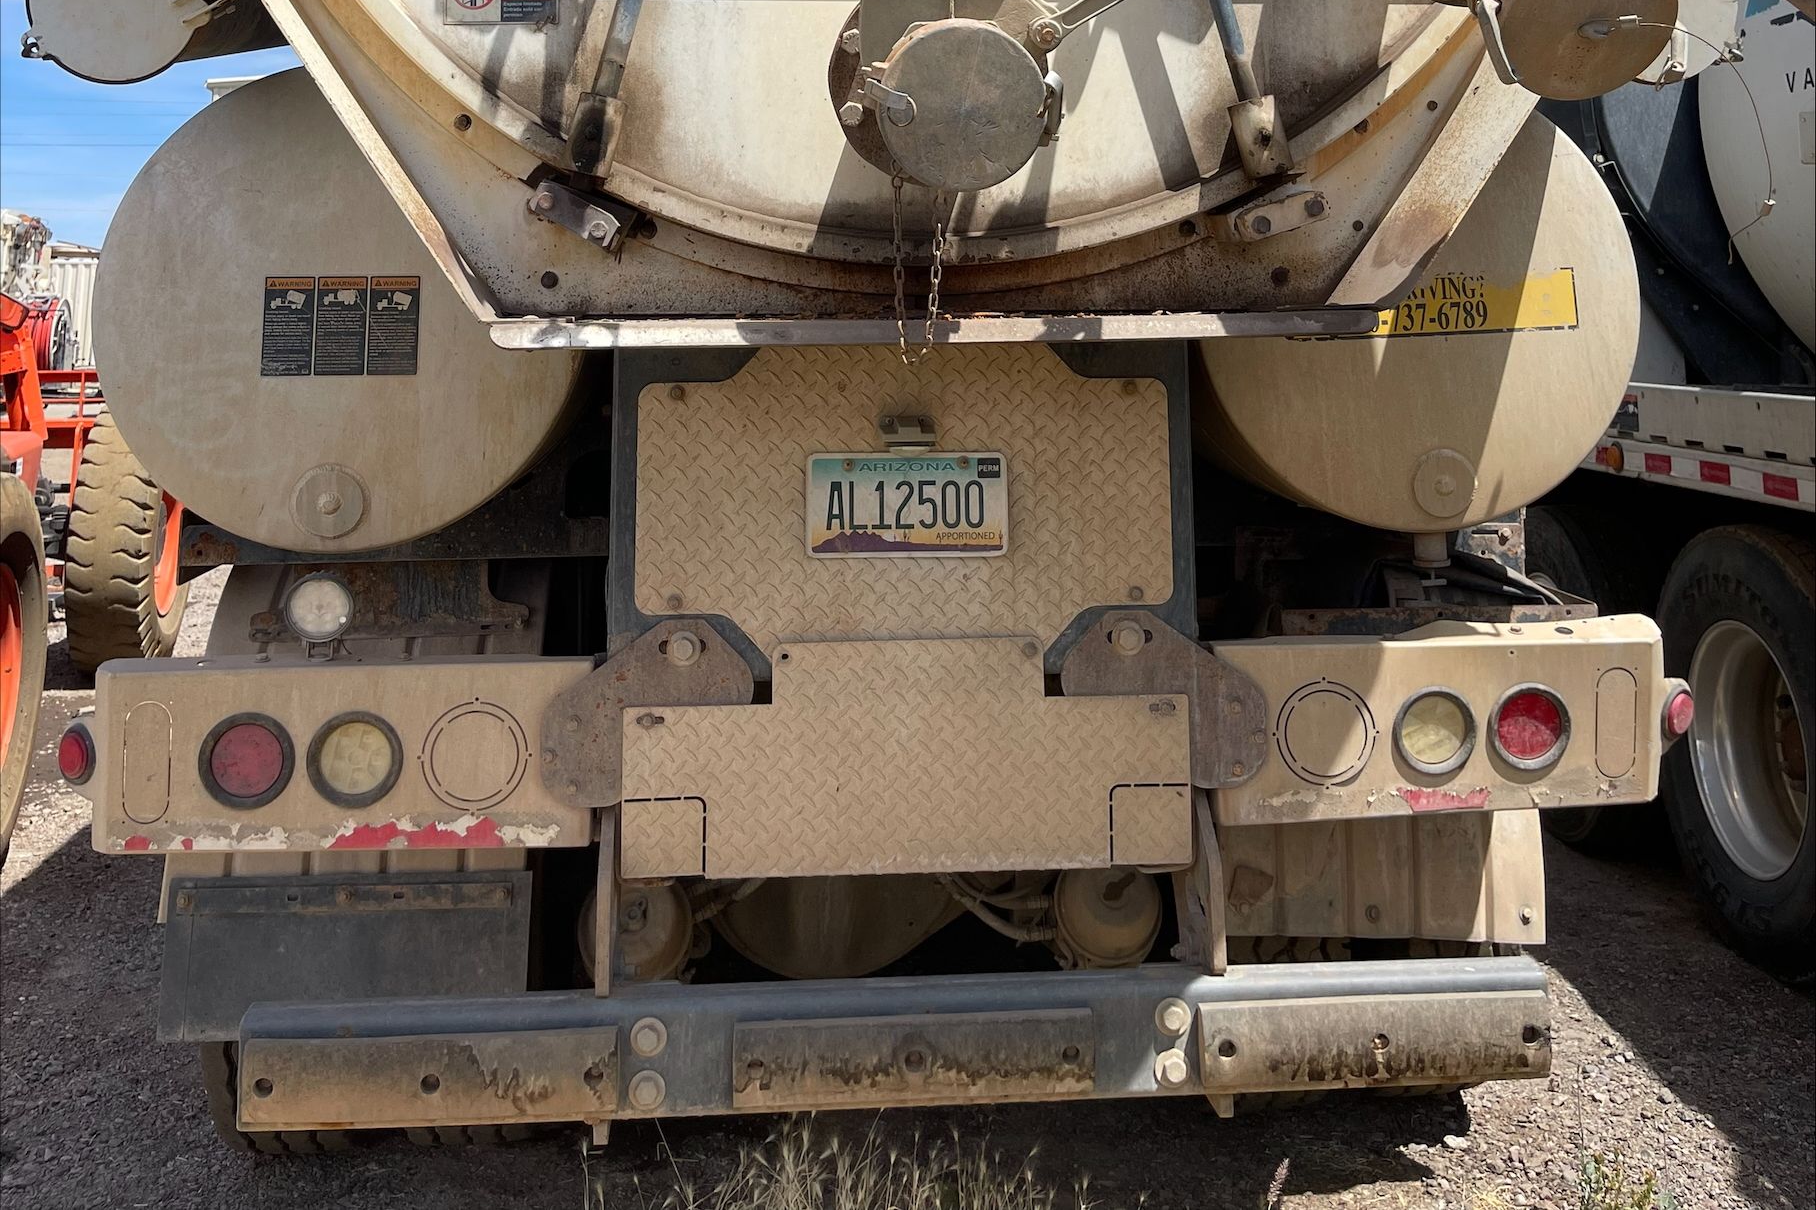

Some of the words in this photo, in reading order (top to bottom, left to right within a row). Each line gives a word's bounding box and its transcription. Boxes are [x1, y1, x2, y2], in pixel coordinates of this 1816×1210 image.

[276, 280, 313, 288] WARNING
[330, 280, 365, 288] WARNING
[858, 462, 956, 472] ARIZONA
[978, 464, 1000, 472] PERM
[826, 480, 984, 530] AL12500
[936, 531, 995, 541] APPORTIONED
